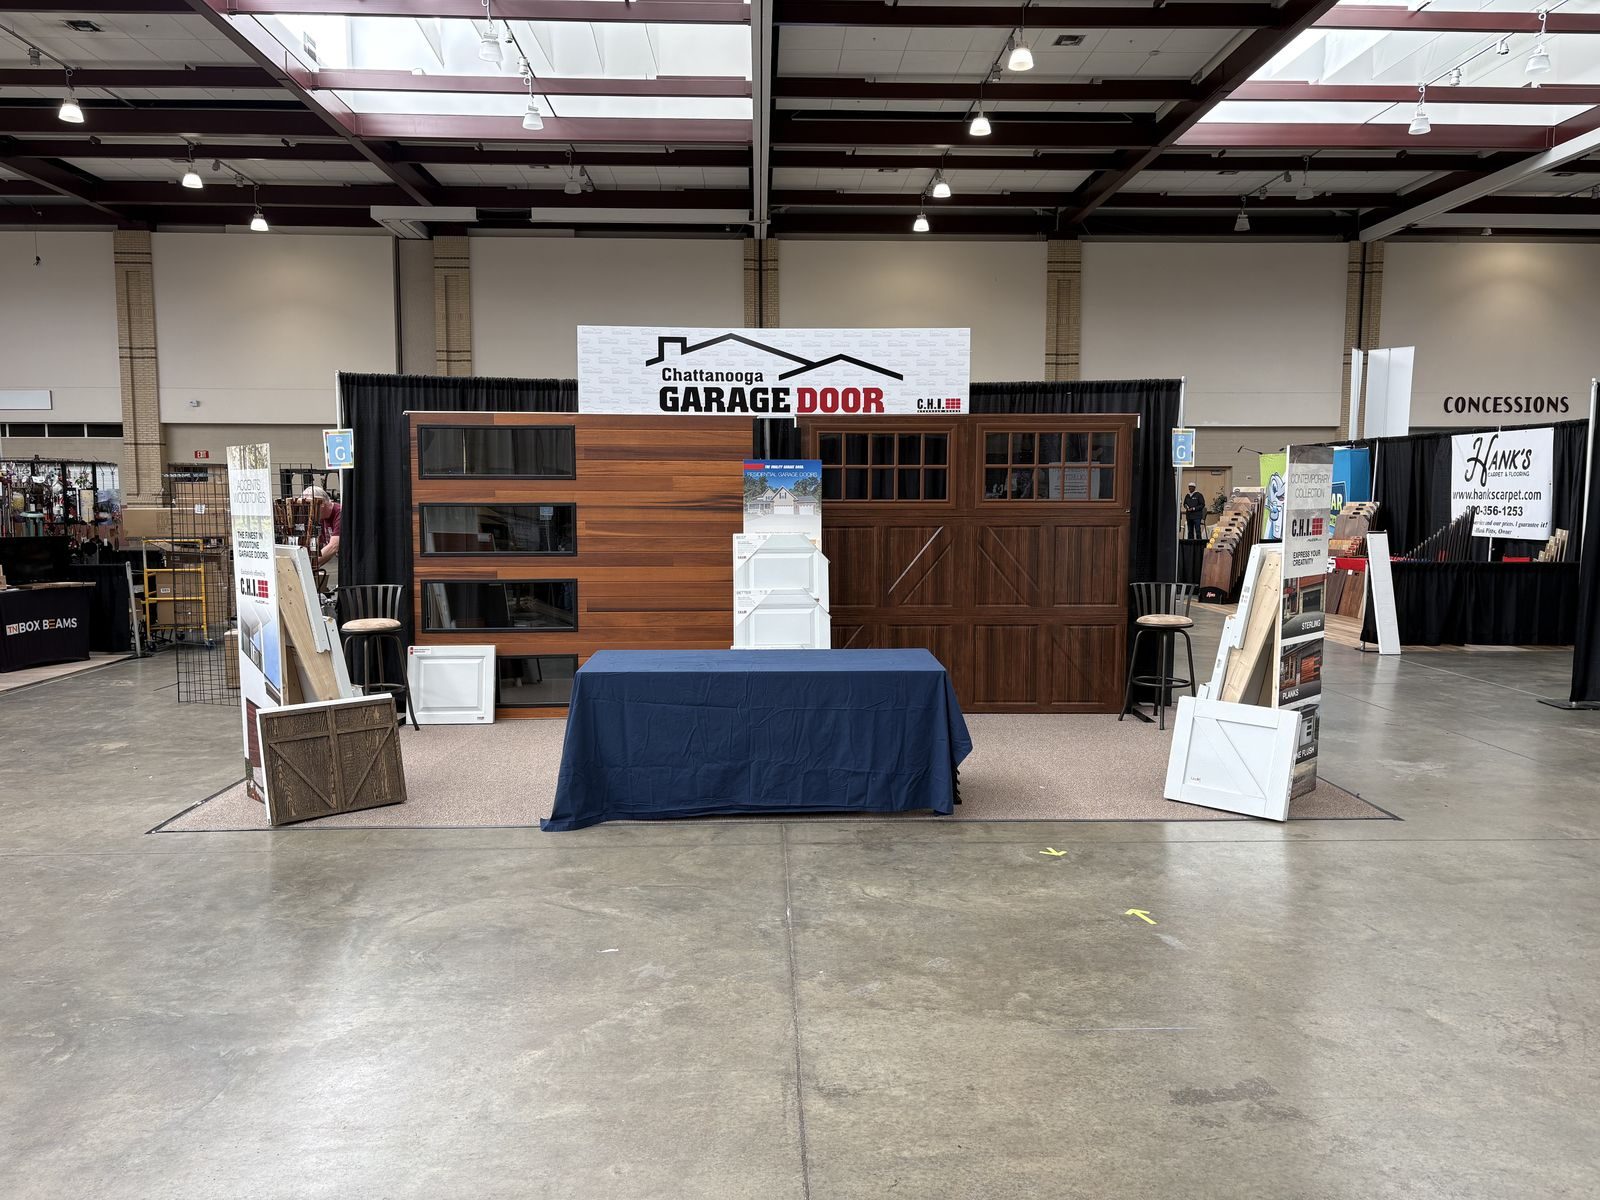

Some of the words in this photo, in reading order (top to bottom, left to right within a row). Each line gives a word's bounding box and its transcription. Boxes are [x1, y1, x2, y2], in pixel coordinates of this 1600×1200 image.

[662, 367, 764, 385] Chattanooga
[660, 386, 791, 413] GARAGE
[796, 387, 885, 413] DOOR
[917, 398, 945, 410] C.H.I.
[1443, 396, 1569, 413] CONCESSIONS
[335, 446, 346, 461] G
[1176, 445, 1186, 459] G
[1464, 433, 1532, 487] HANK'S
[1290, 473, 1330, 484] CONTEMPORARY
[236, 479, 261, 491] ACCENTS
[233, 491, 267, 504] WOODTONES
[1295, 488, 1325, 498] COLLECTION
[1452, 488, 1542, 503] www.hankscarpet.com
[1291, 518, 1312, 537] C.H.I.
[237, 531, 245, 540] THE
[245, 531, 258, 540] FINEST
[258, 531, 264, 540] IN
[238, 540, 260, 549] WOODTONE
[238, 550, 254, 559] GARAGE
[1293, 550, 1311, 559] EXPRESS
[1310, 549, 1321, 557] YOUR
[1293, 558, 1314, 567] CREATIVITY
[240, 577, 258, 597] C.H.I.
[18, 620, 41, 633] BOX
[42, 617, 78, 630] BEAMS
[1301, 619, 1321, 631] STERLING
[1282, 688, 1300, 700] PLANKS
